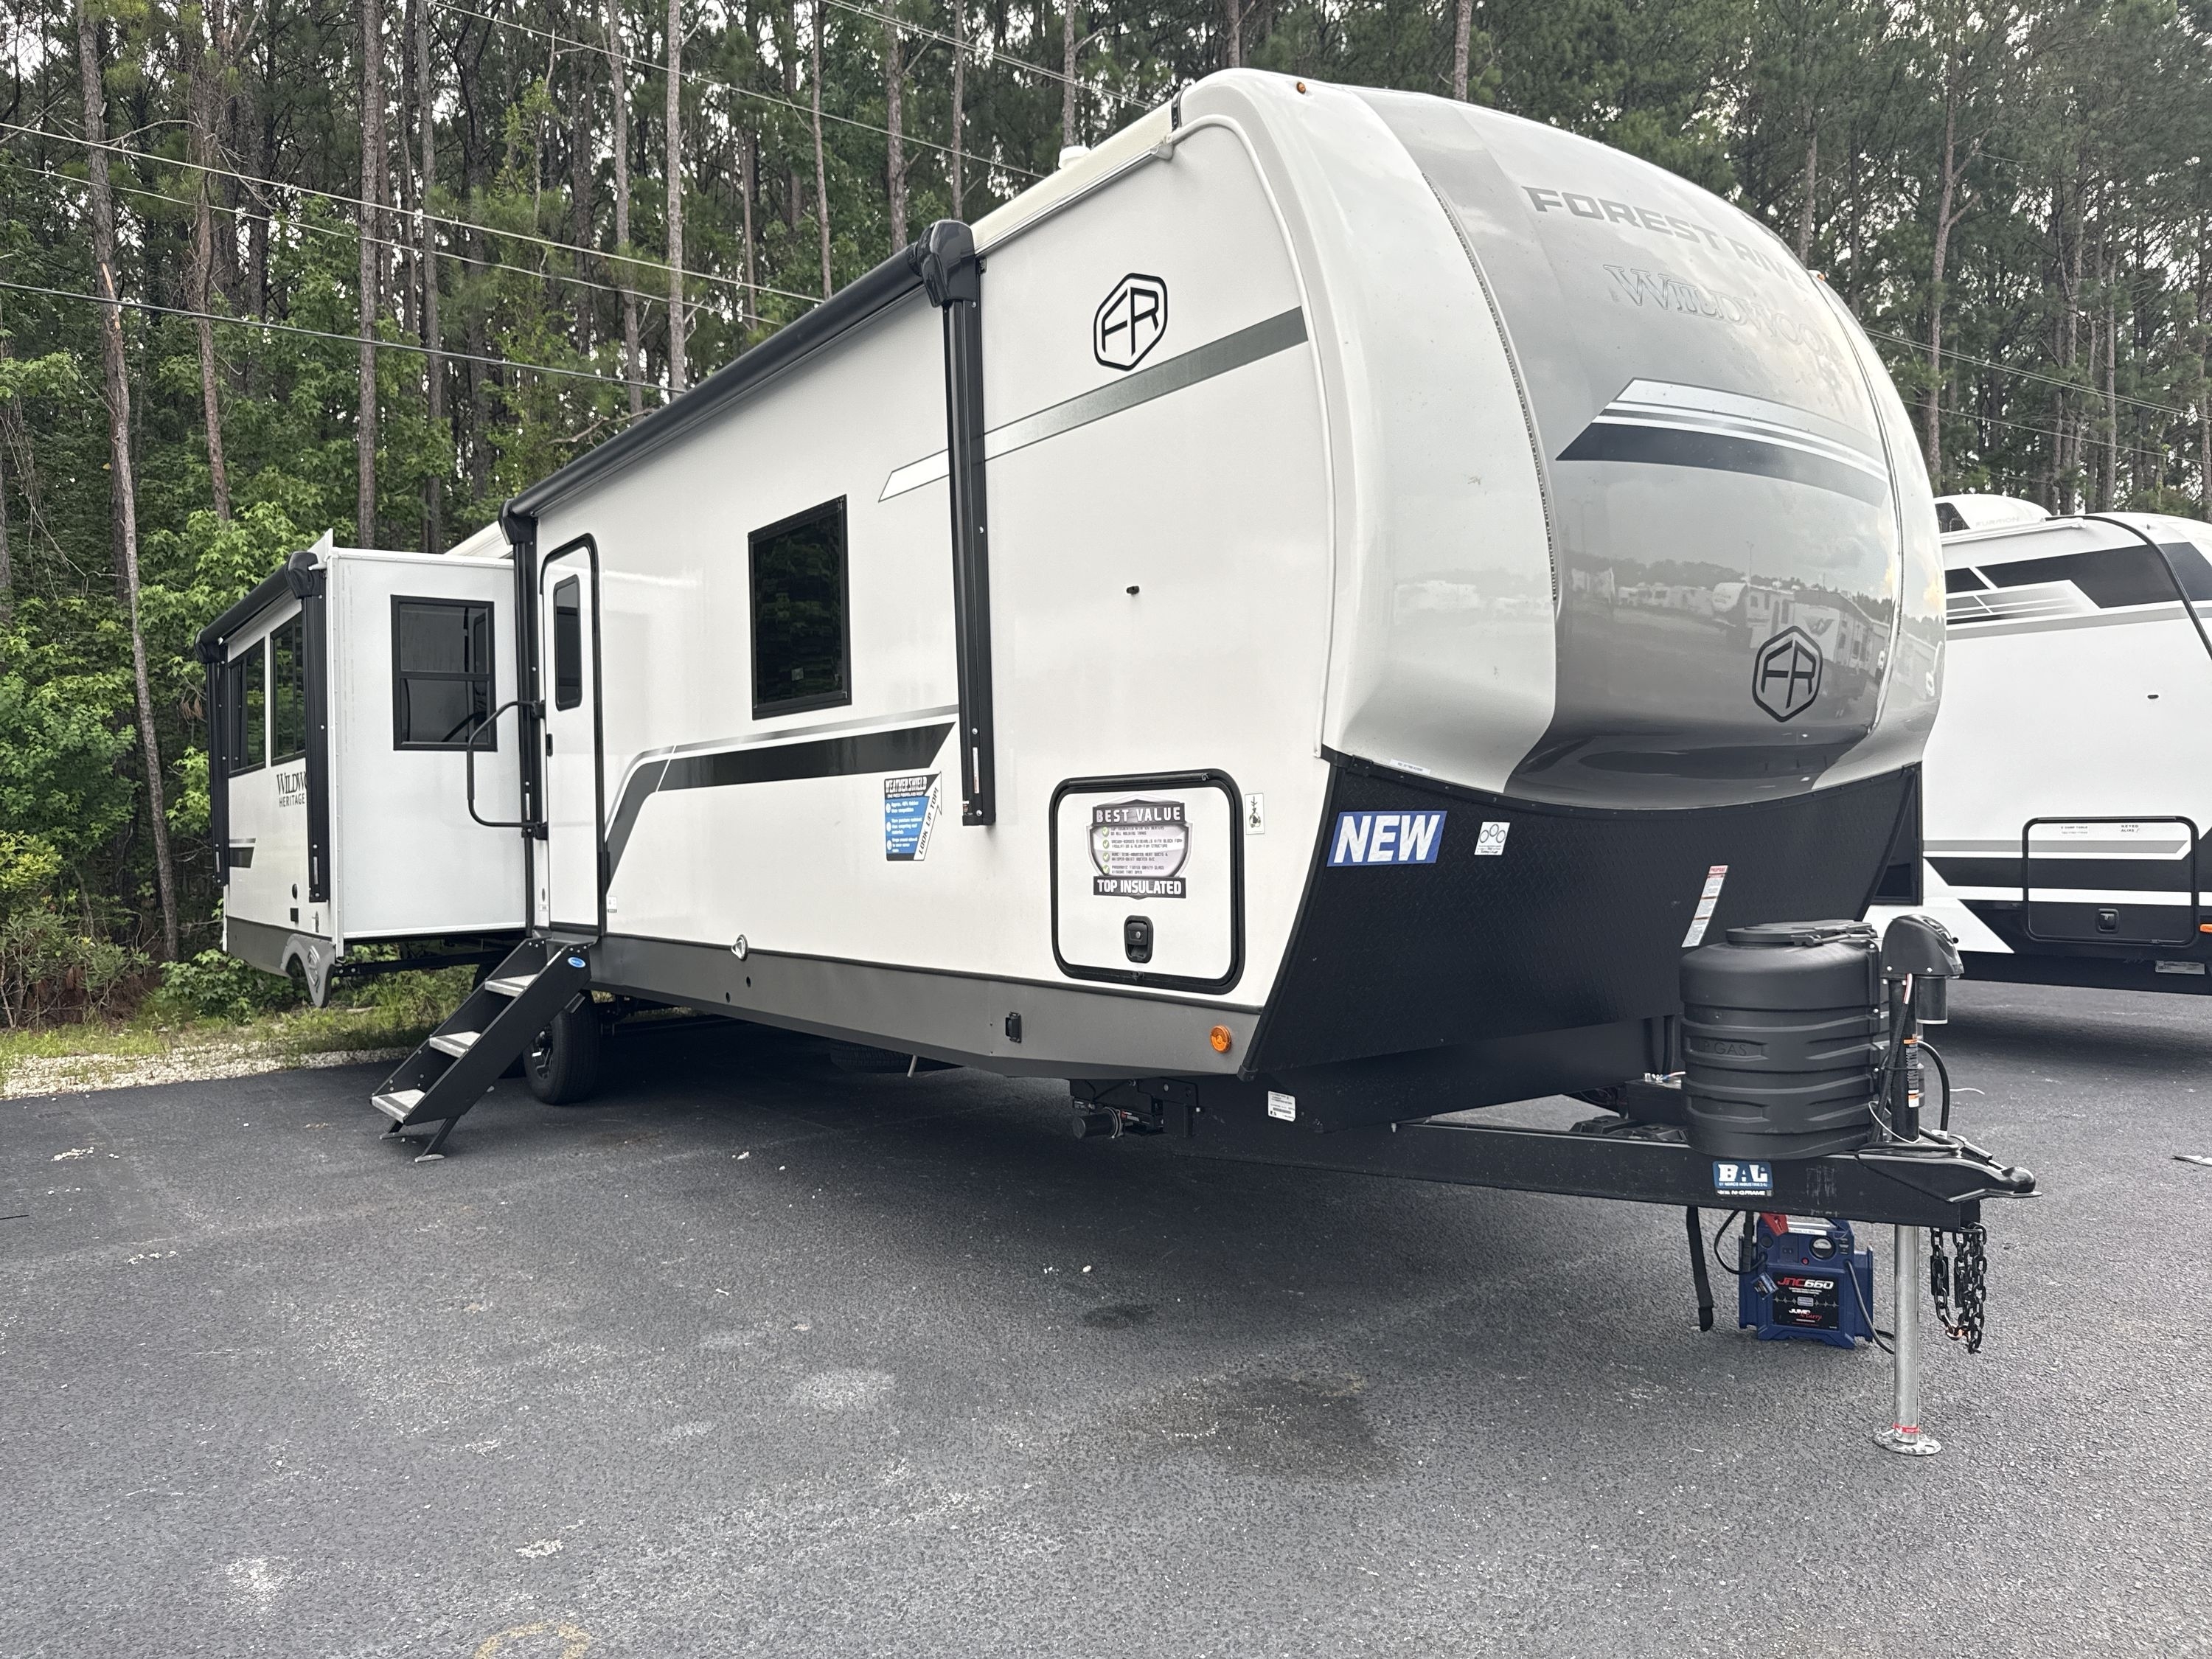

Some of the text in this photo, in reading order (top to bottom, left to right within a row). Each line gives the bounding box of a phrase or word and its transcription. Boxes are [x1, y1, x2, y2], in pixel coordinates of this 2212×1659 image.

[1520, 186, 1809, 293] FOREST RIVE
[276, 771, 307, 795] WILDW
[886, 776, 928, 793] WEATHER SHIELD
[279, 793, 305, 807] HERITAGE
[1096, 807, 1180, 823] BEST VALUE
[919, 830, 928, 855] LOOK
[926, 813, 932, 827] UP
[1334, 815, 1441, 863] NEW
[1097, 879, 1182, 894] TOP INSULATED
[1714, 1042, 1747, 1056] GAS
[1718, 1164, 1768, 1182] BAL
